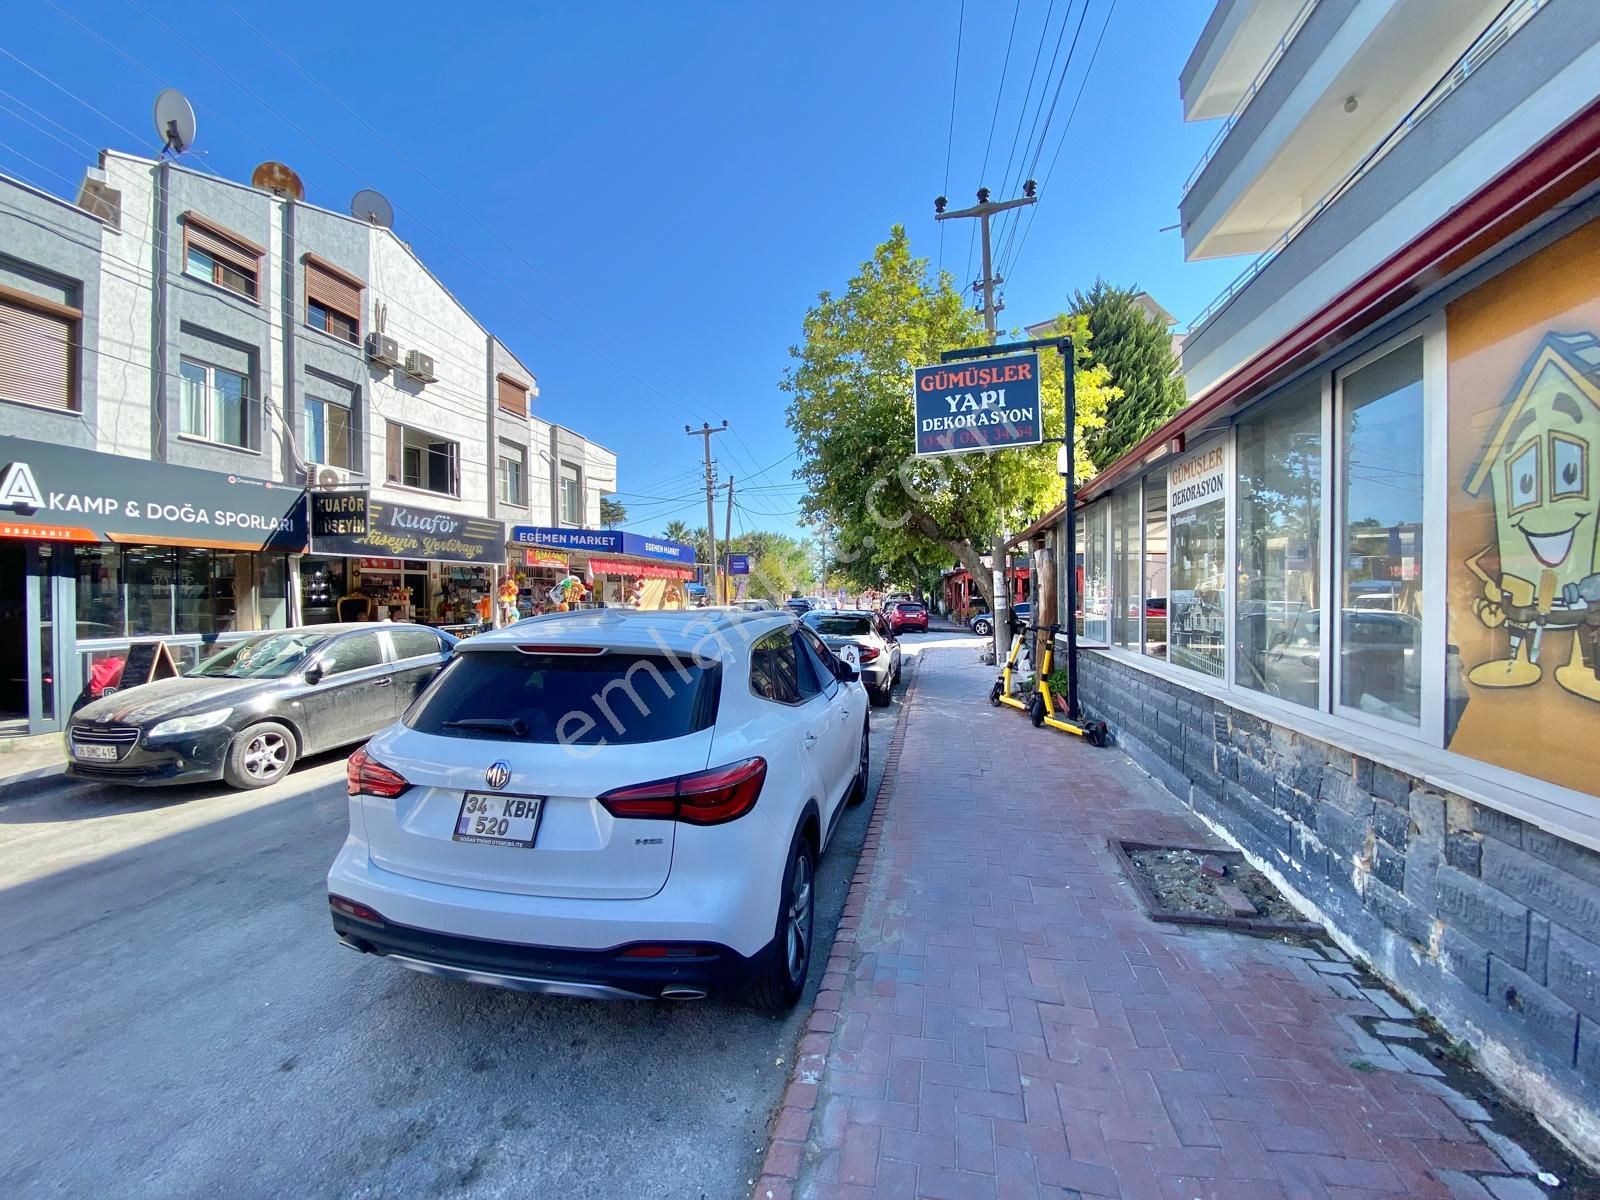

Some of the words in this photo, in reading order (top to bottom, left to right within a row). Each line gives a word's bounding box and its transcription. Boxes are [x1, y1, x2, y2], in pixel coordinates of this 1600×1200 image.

[921, 363, 1032, 391] GÜMÜŞLER
[945, 389, 1006, 413] YAPI
[922, 407, 1033, 432] DEKORASYON
[1172, 446, 1224, 486] GÜMÜŞLER
[1172, 473, 1224, 507] DEKORASYON
[50, 492, 119, 515] KAMP
[125, 501, 140, 518] &
[147, 503, 210, 524] DOĞA
[214, 510, 293, 532] SPORLARI
[391, 507, 457, 533] Kuaför
[316, 516, 365, 534] ÜSEYİN
[520, 532, 567, 544] EGEMEN
[570, 535, 615, 546] MARKET
[645, 542, 663, 553] EGEMEN
[663, 546, 680, 556] MARKET
[487, 762, 507, 787] MG
[466, 796, 487, 814] 34
[502, 799, 538, 819] KBH
[475, 816, 509, 836] 520
